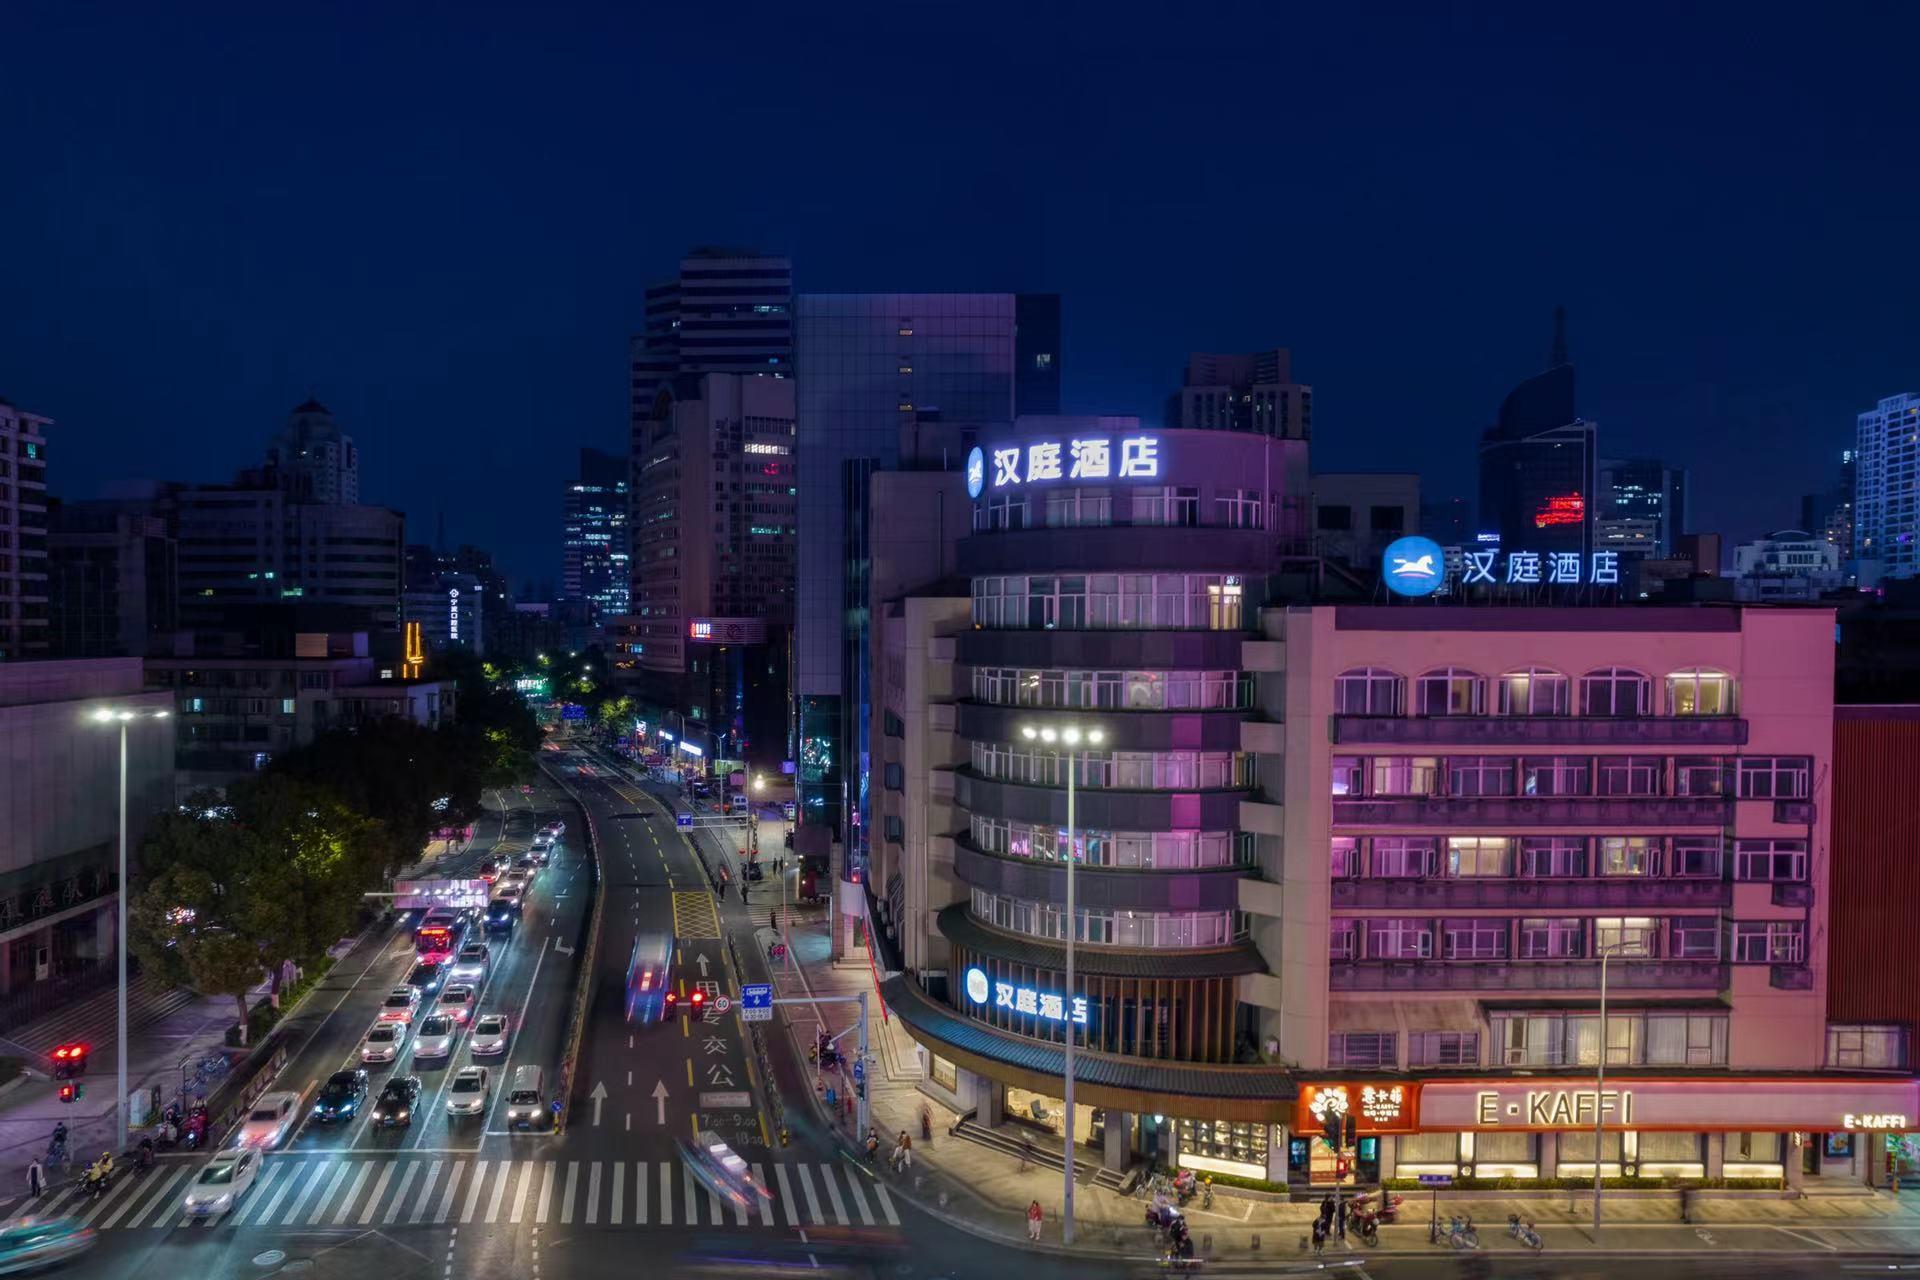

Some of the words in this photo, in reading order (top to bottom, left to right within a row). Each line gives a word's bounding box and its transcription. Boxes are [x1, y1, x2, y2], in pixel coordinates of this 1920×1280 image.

[993, 437, 1158, 487] 汉庭酒店
[1462, 551, 1618, 584] 汉庭酒店
[717, 1000, 727, 1008] 60
[995, 982, 1088, 1023] 汉庭酒店
